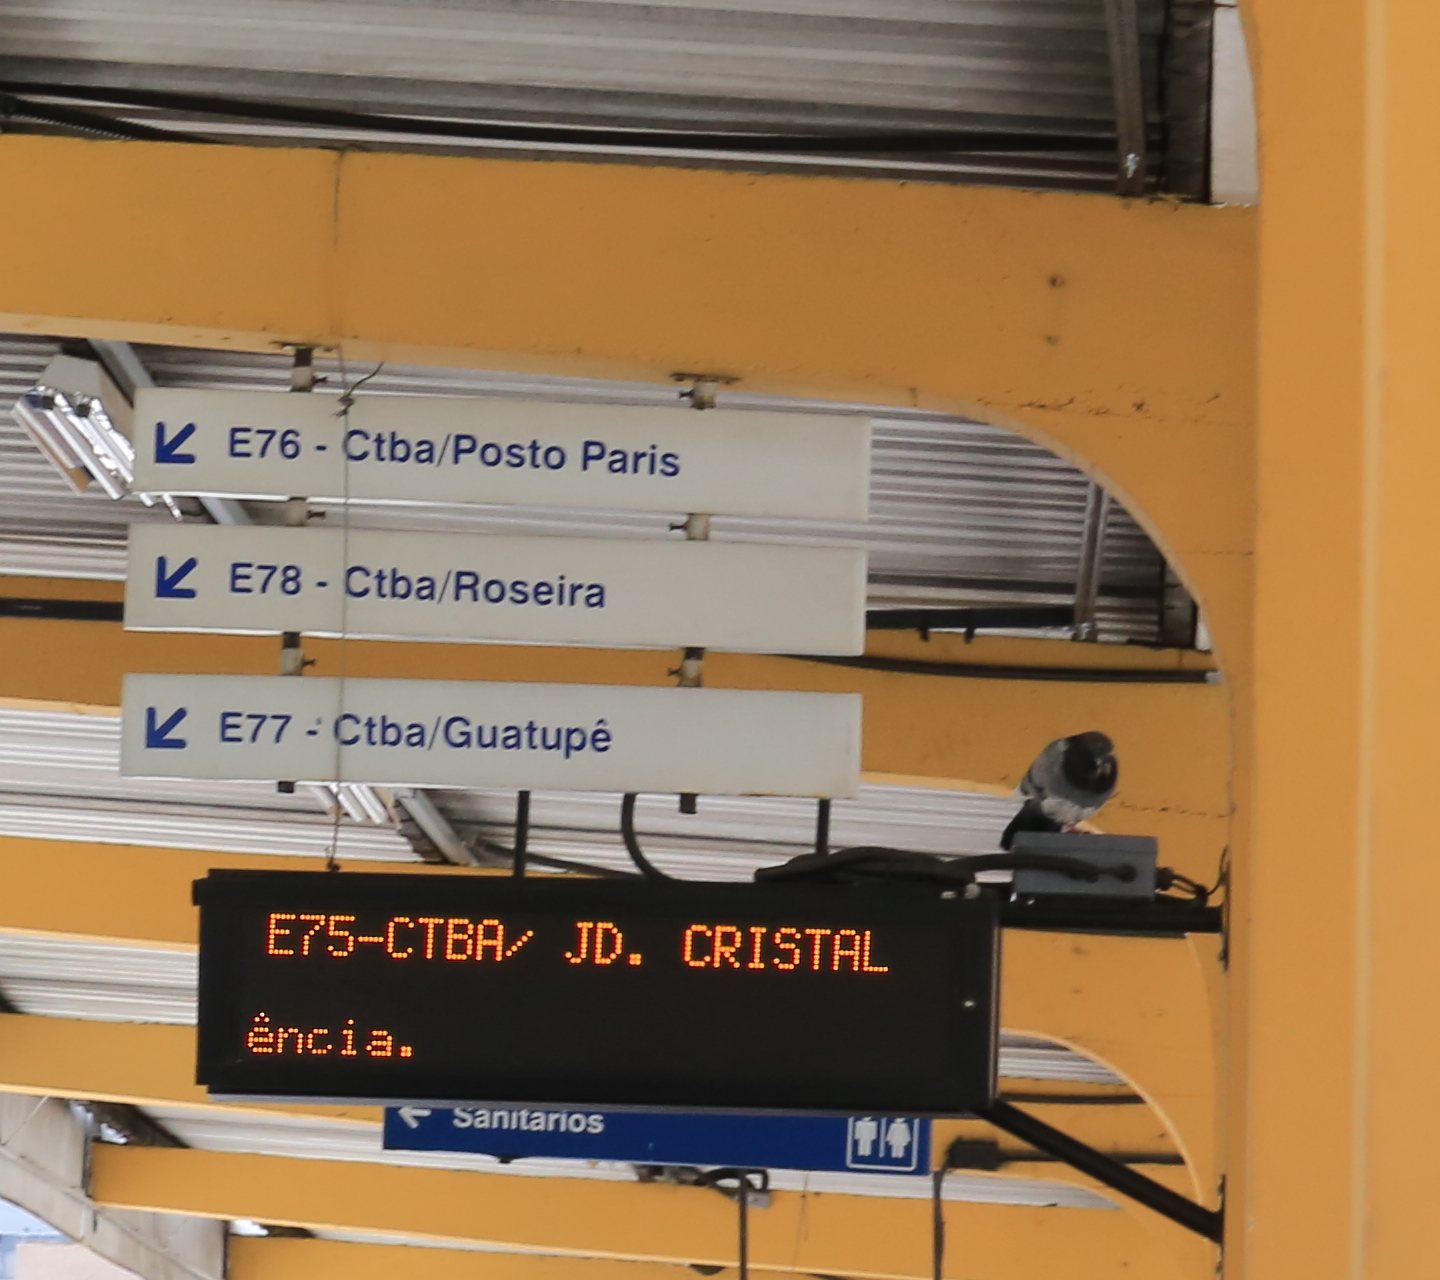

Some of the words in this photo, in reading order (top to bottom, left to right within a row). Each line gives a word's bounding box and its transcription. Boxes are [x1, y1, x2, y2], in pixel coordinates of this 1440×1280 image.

[228, 427, 301, 460] E76
[343, 429, 567, 471] Ctba/Posto
[580, 440, 681, 478] Paris
[229, 562, 302, 596] E78
[344, 565, 607, 608] Ctba/Roseira
[218, 711, 293, 744] E77
[333, 713, 613, 760] Ctba/Guatupê
[267, 912, 535, 961] E75-CTBA/
[564, 920, 642, 966] JD.
[683, 924, 890, 973] CRISTAL
[246, 1011, 413, 1058] ência.
